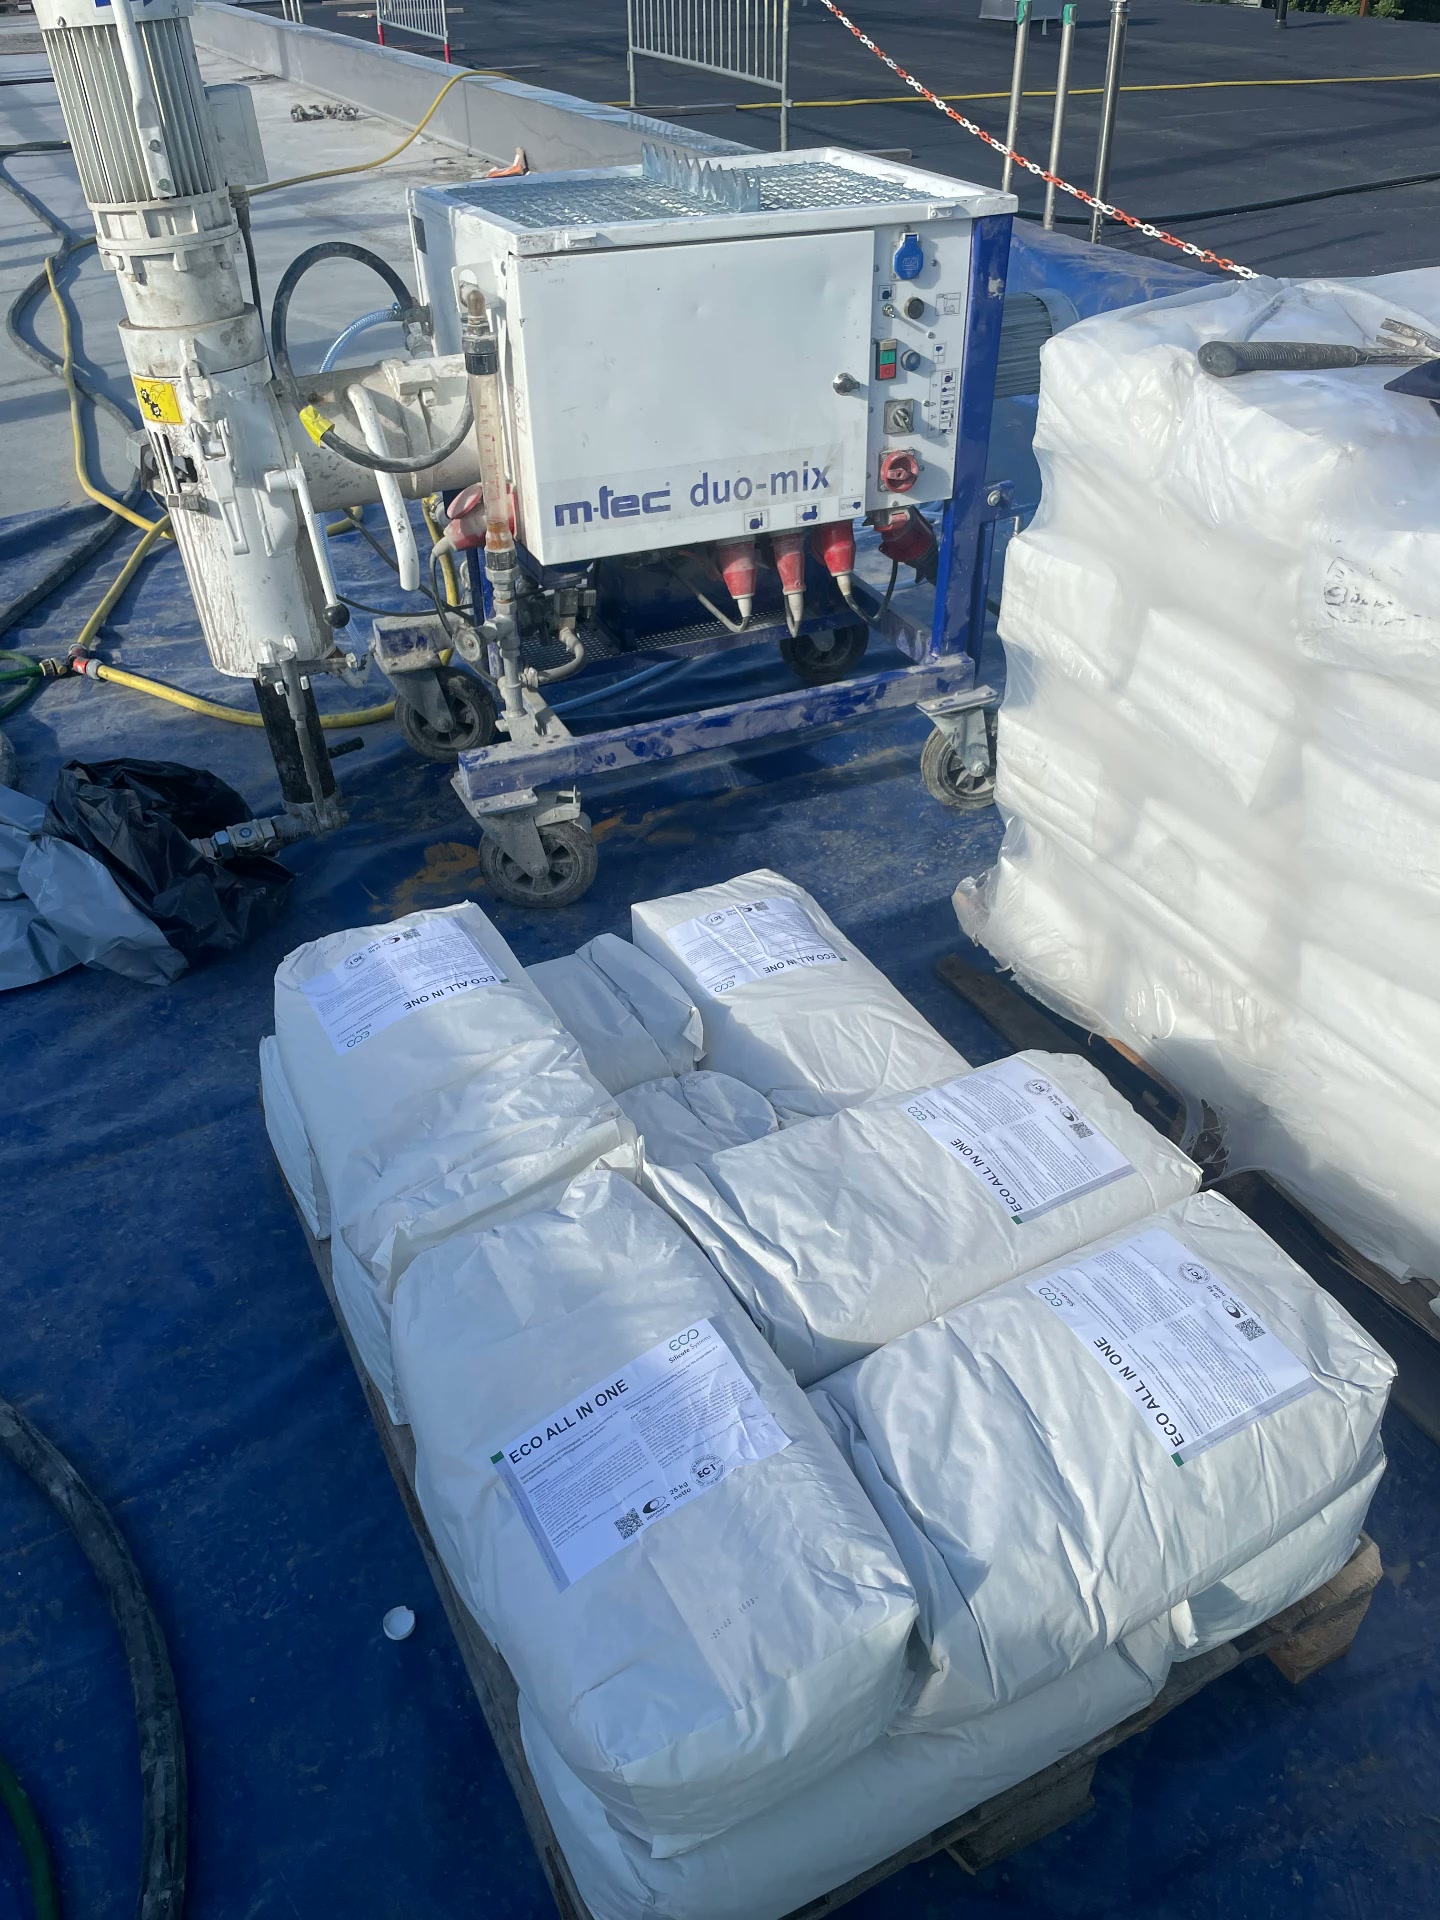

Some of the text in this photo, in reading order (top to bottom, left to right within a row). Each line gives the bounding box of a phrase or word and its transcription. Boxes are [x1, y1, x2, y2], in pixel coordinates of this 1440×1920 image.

[690, 461, 832, 507] duo-mix
[763, 953, 838, 974] ECO ALL IN ONE
[403, 975, 496, 1010] ECO ALL IN ONE
[950, 1138, 1024, 1213] ECO ALL IN ONE
[1093, 1336, 1185, 1448] ECO ALL IN ONE
[508, 1434, 544, 1464] ECO
[546, 1416, 577, 1441] ALL
[576, 1401, 594, 1421] IN
[594, 1378, 629, 1408] ONE
[678, 1481, 689, 1492] kg
[697, 1466, 711, 1479] EC
[673, 1487, 692, 1501] netto
